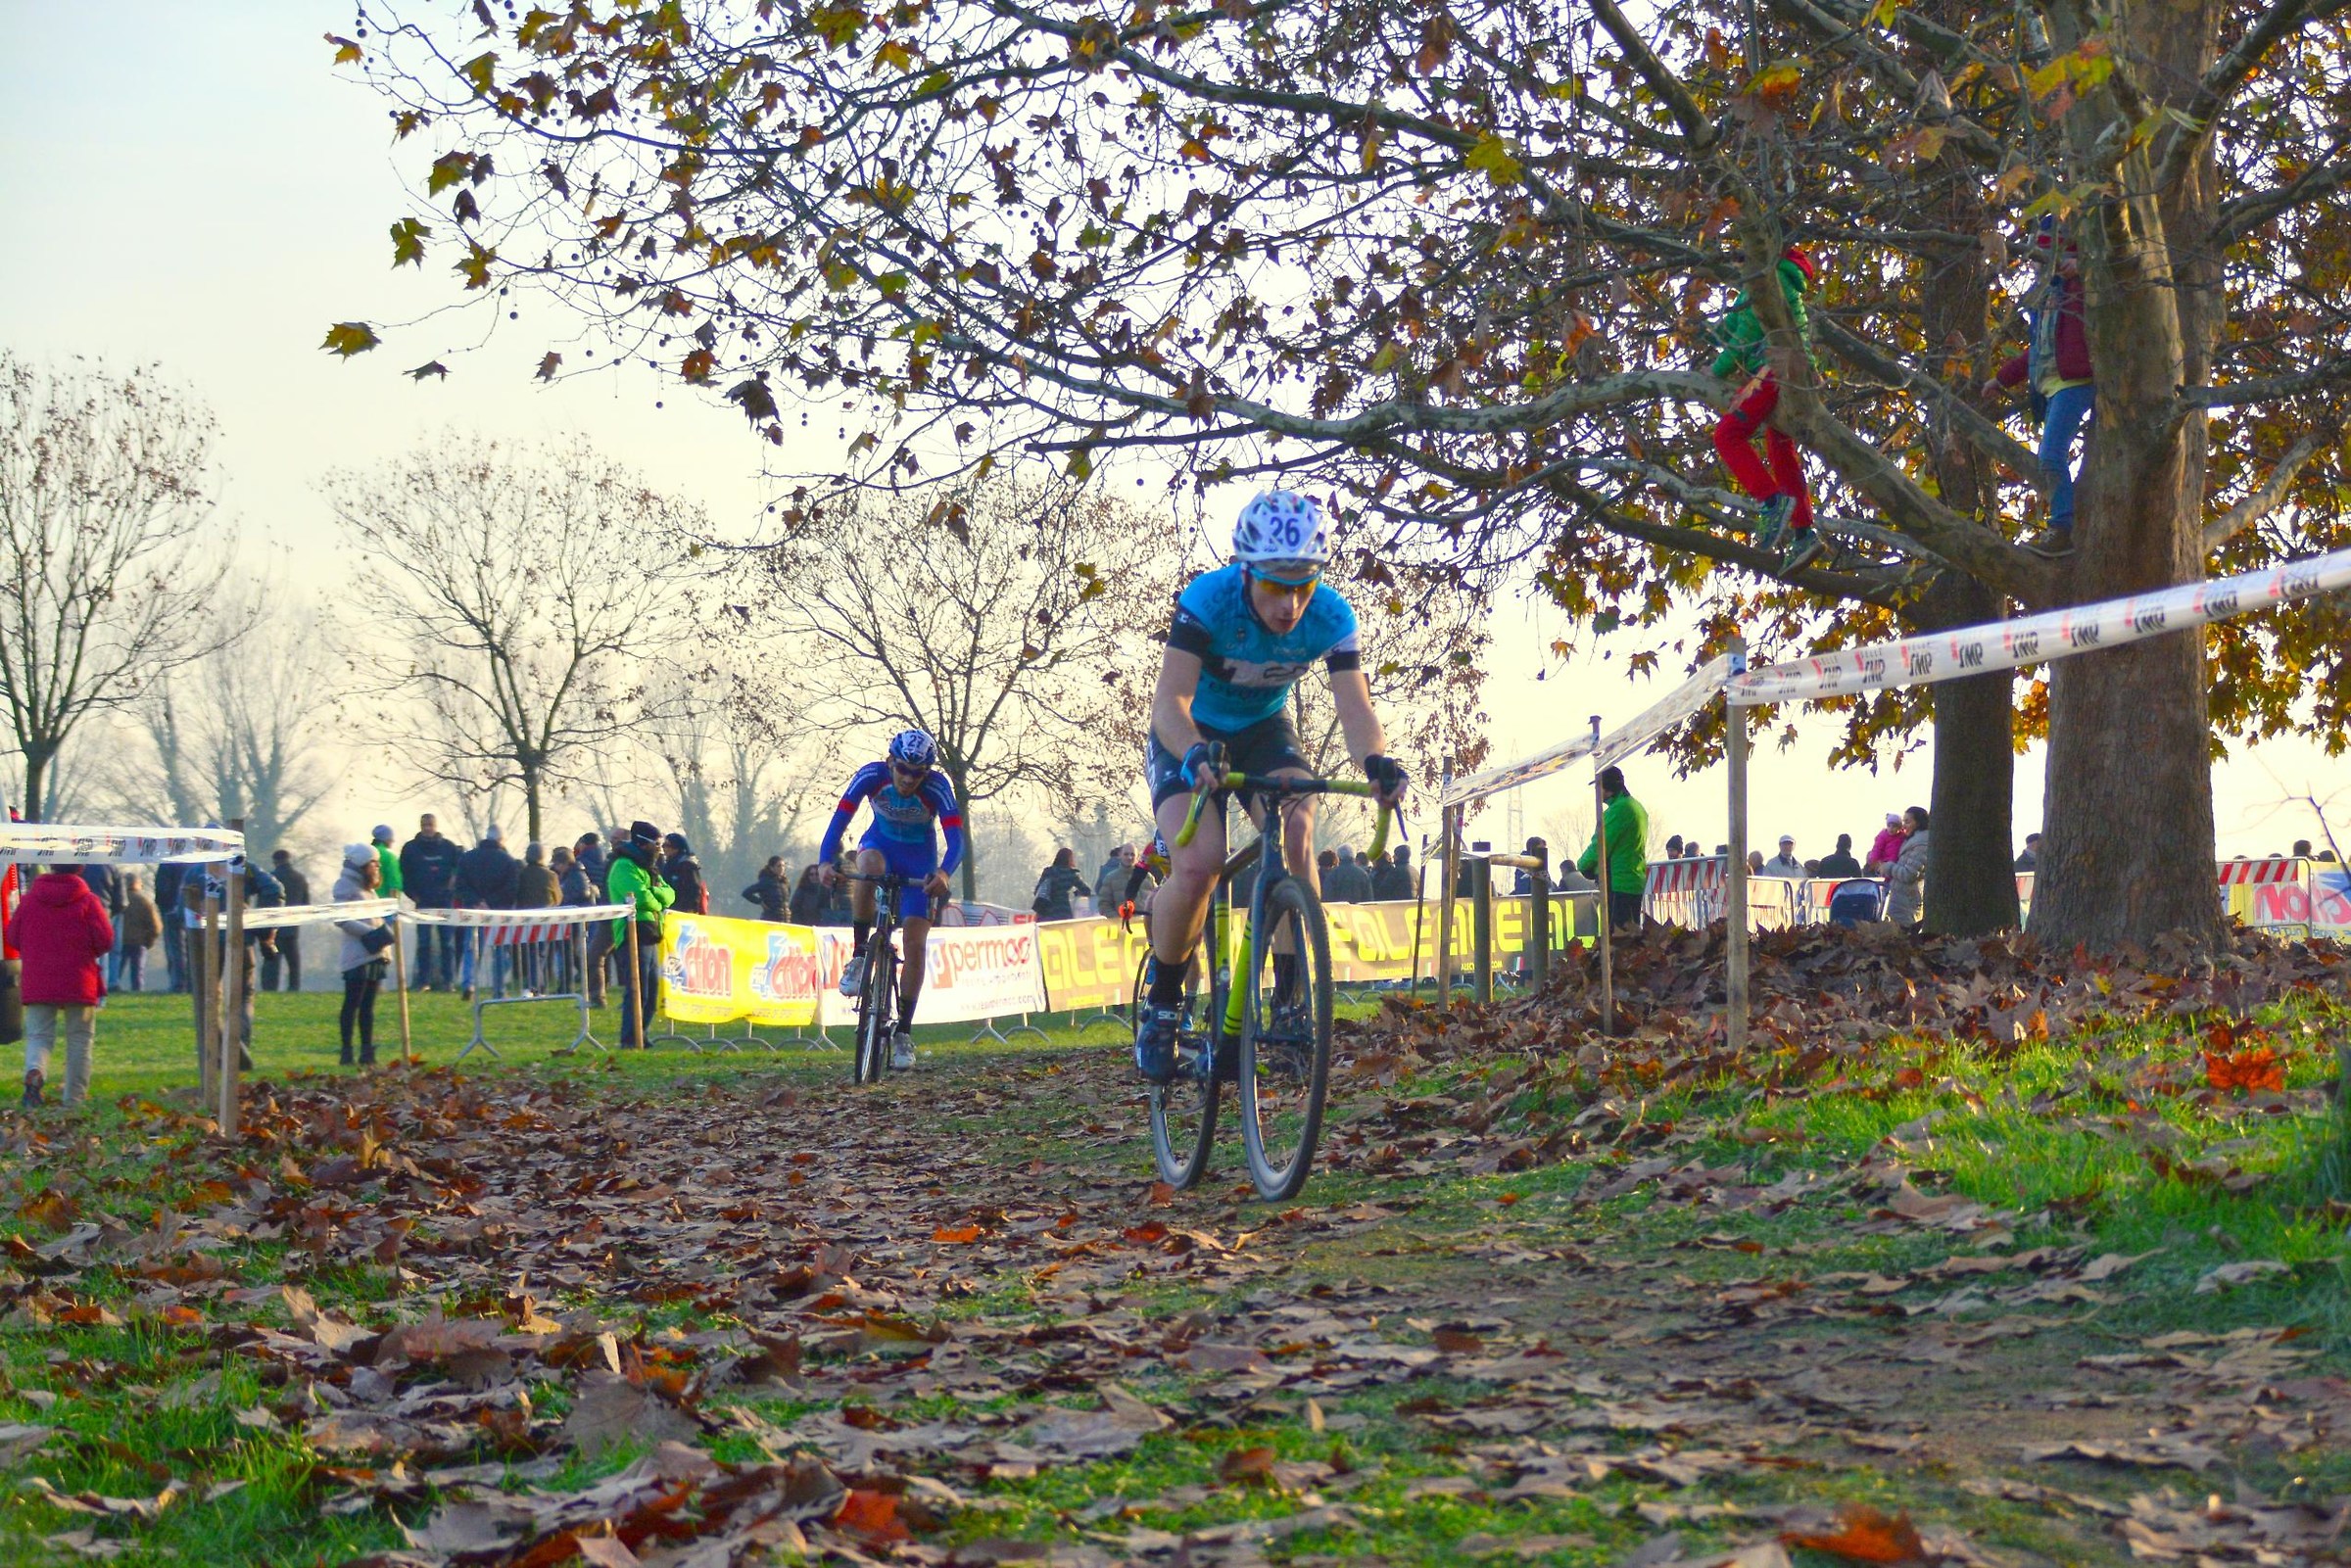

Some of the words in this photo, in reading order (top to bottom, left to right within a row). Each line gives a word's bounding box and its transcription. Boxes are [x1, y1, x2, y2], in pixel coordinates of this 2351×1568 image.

[1270, 515, 1300, 547] 26
[1959, 641, 1983, 668] SMP
[948, 935, 1031, 981] permac
